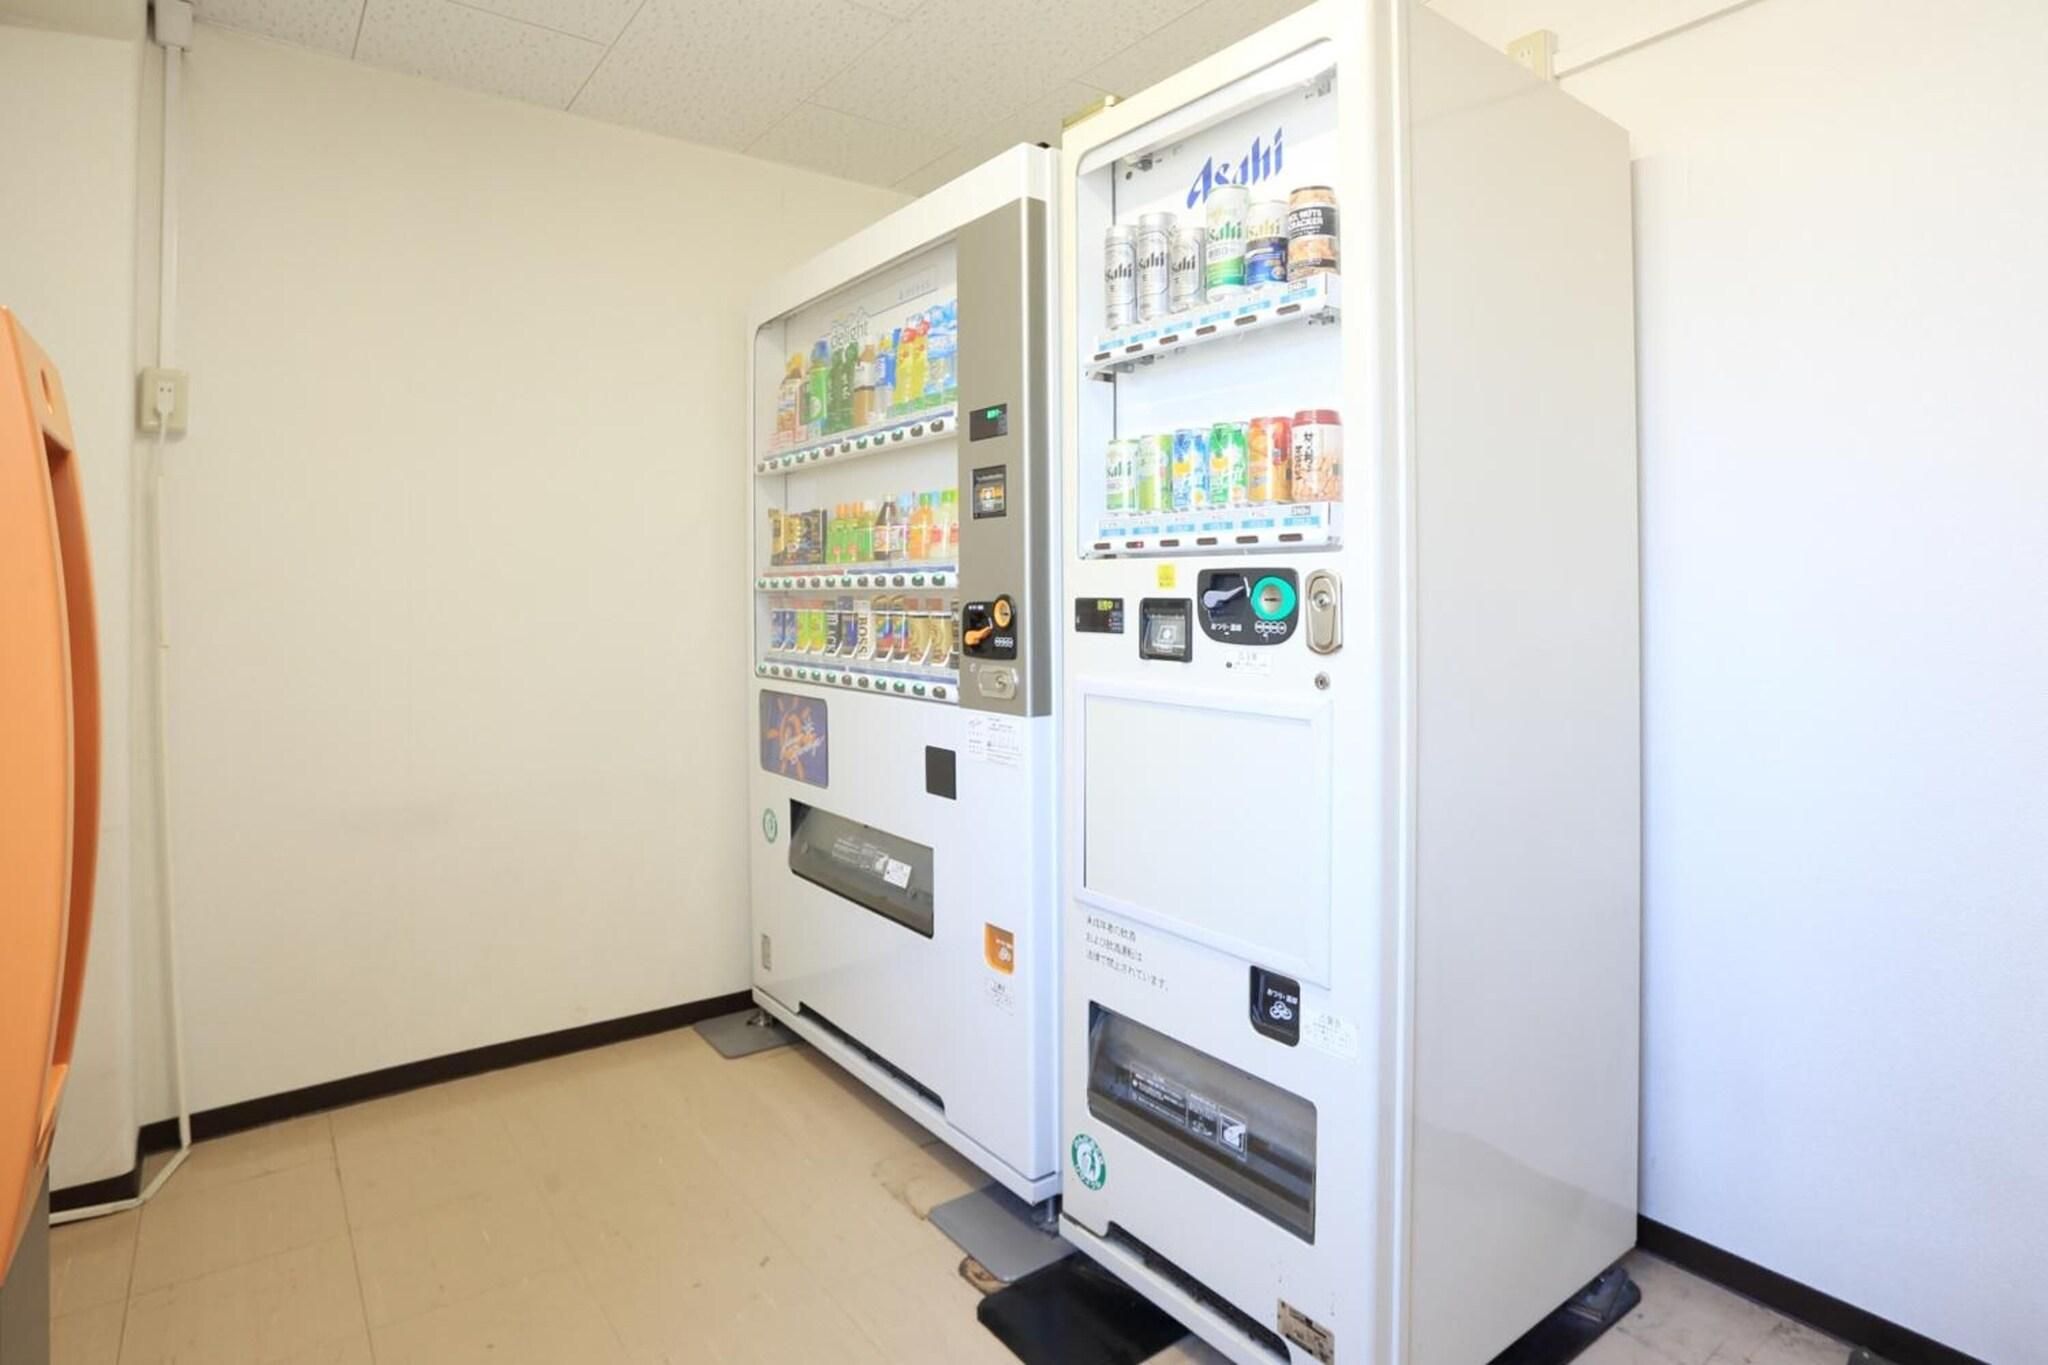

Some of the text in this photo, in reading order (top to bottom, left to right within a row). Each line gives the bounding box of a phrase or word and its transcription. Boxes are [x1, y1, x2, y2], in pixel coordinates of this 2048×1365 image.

[1186, 127, 1283, 209] Asahi
[1208, 221, 1242, 240] sahi
[1138, 251, 1164, 269] sahi
[1105, 263, 1132, 281] sahi
[858, 616, 869, 654] BOSS
